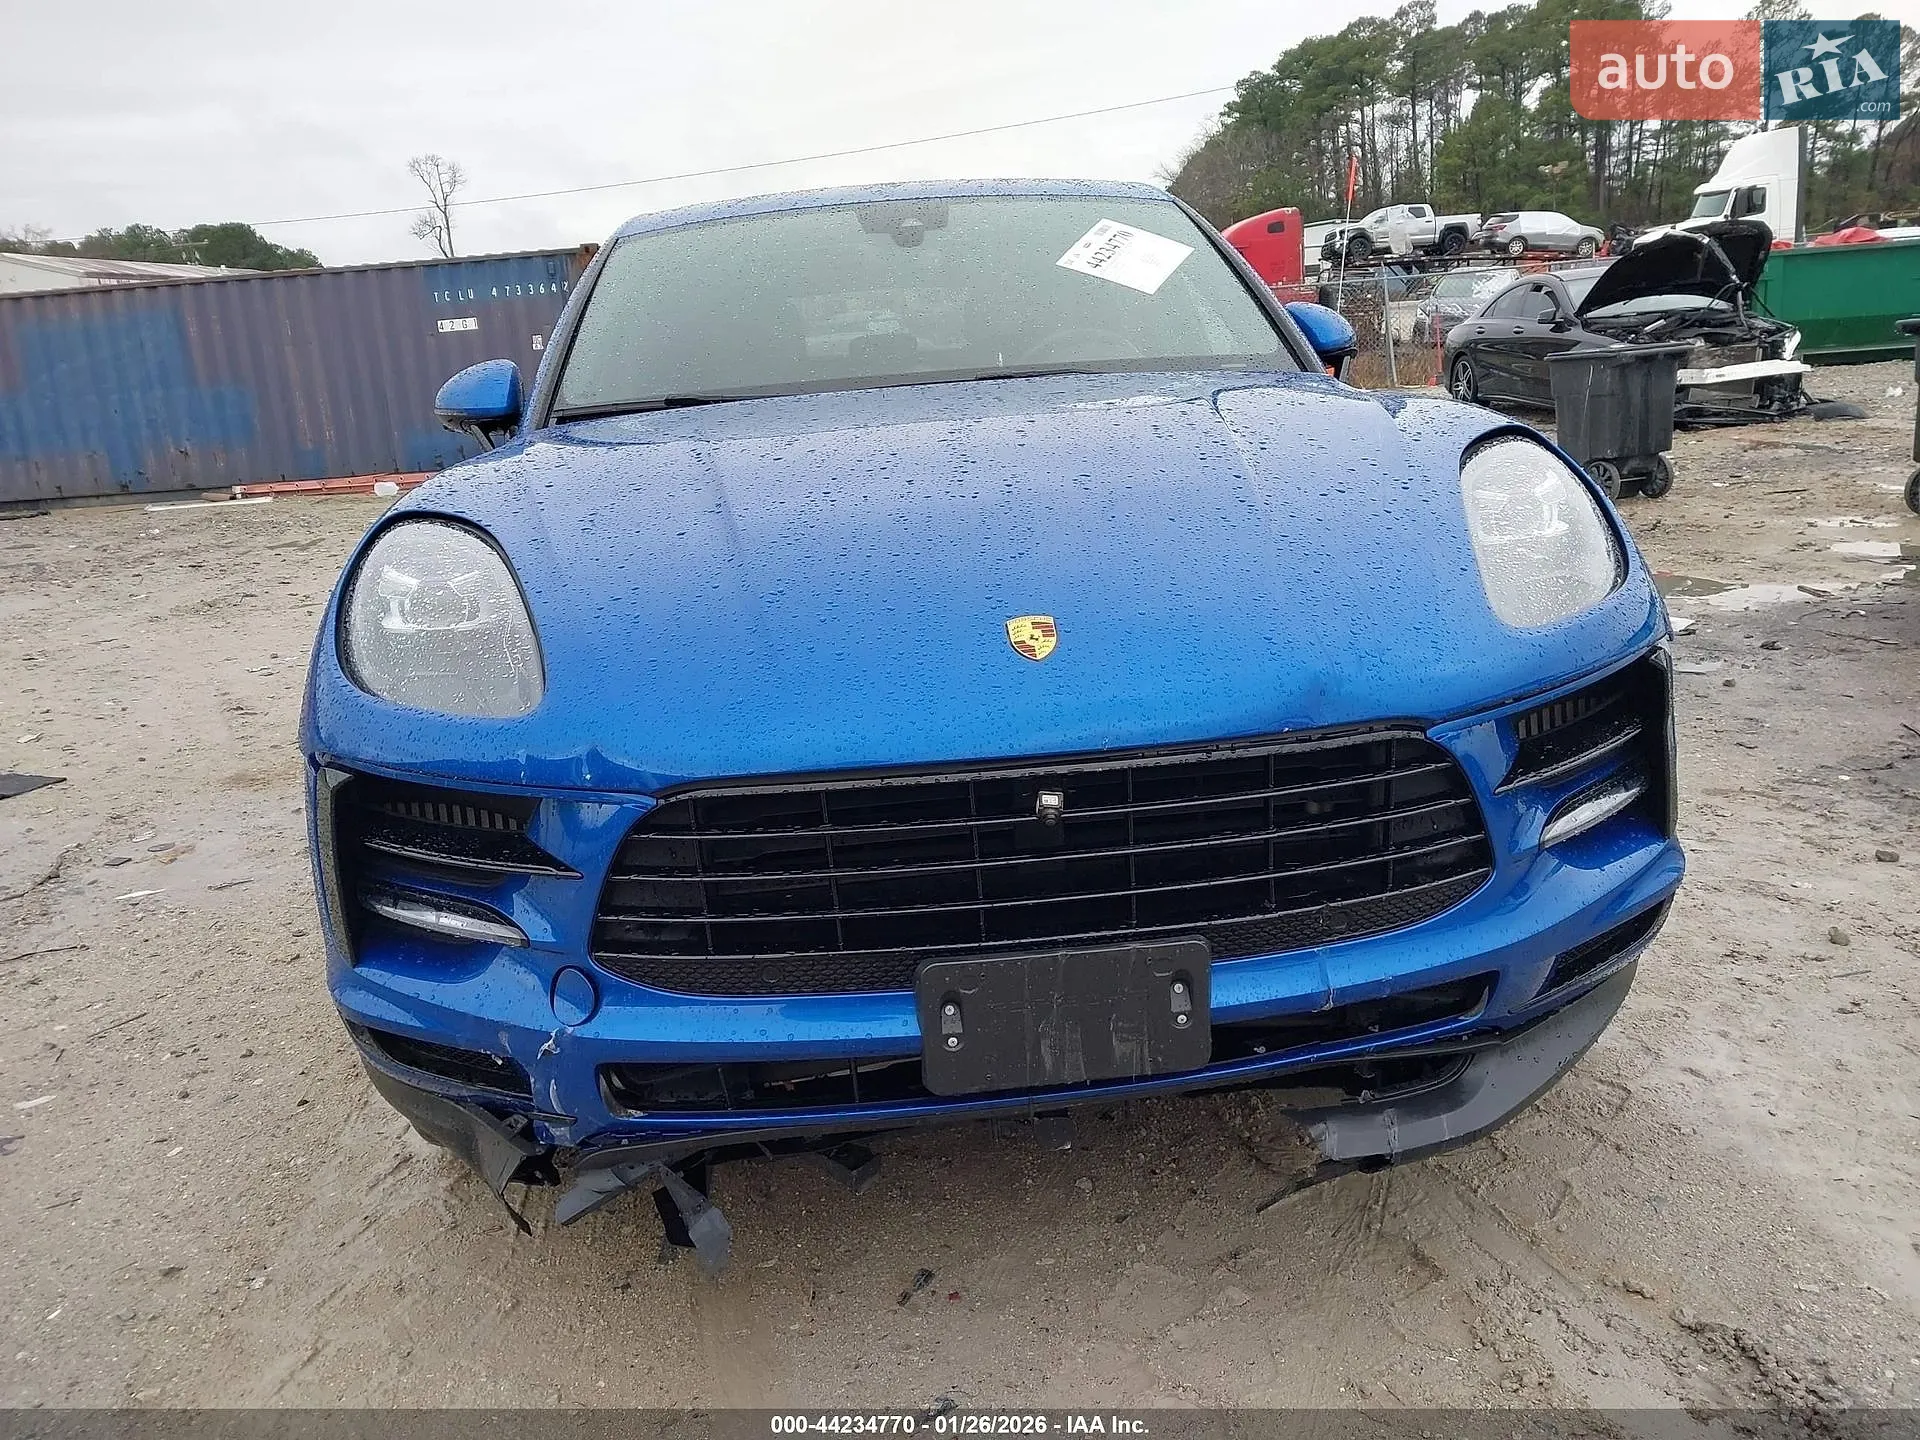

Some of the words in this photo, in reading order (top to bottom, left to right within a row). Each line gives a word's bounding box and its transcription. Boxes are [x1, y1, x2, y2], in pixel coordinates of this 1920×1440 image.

[1086, 231, 1134, 268] 44234770
[434, 288, 473, 302] TCLU
[439, 318, 478, 331] 42G1
